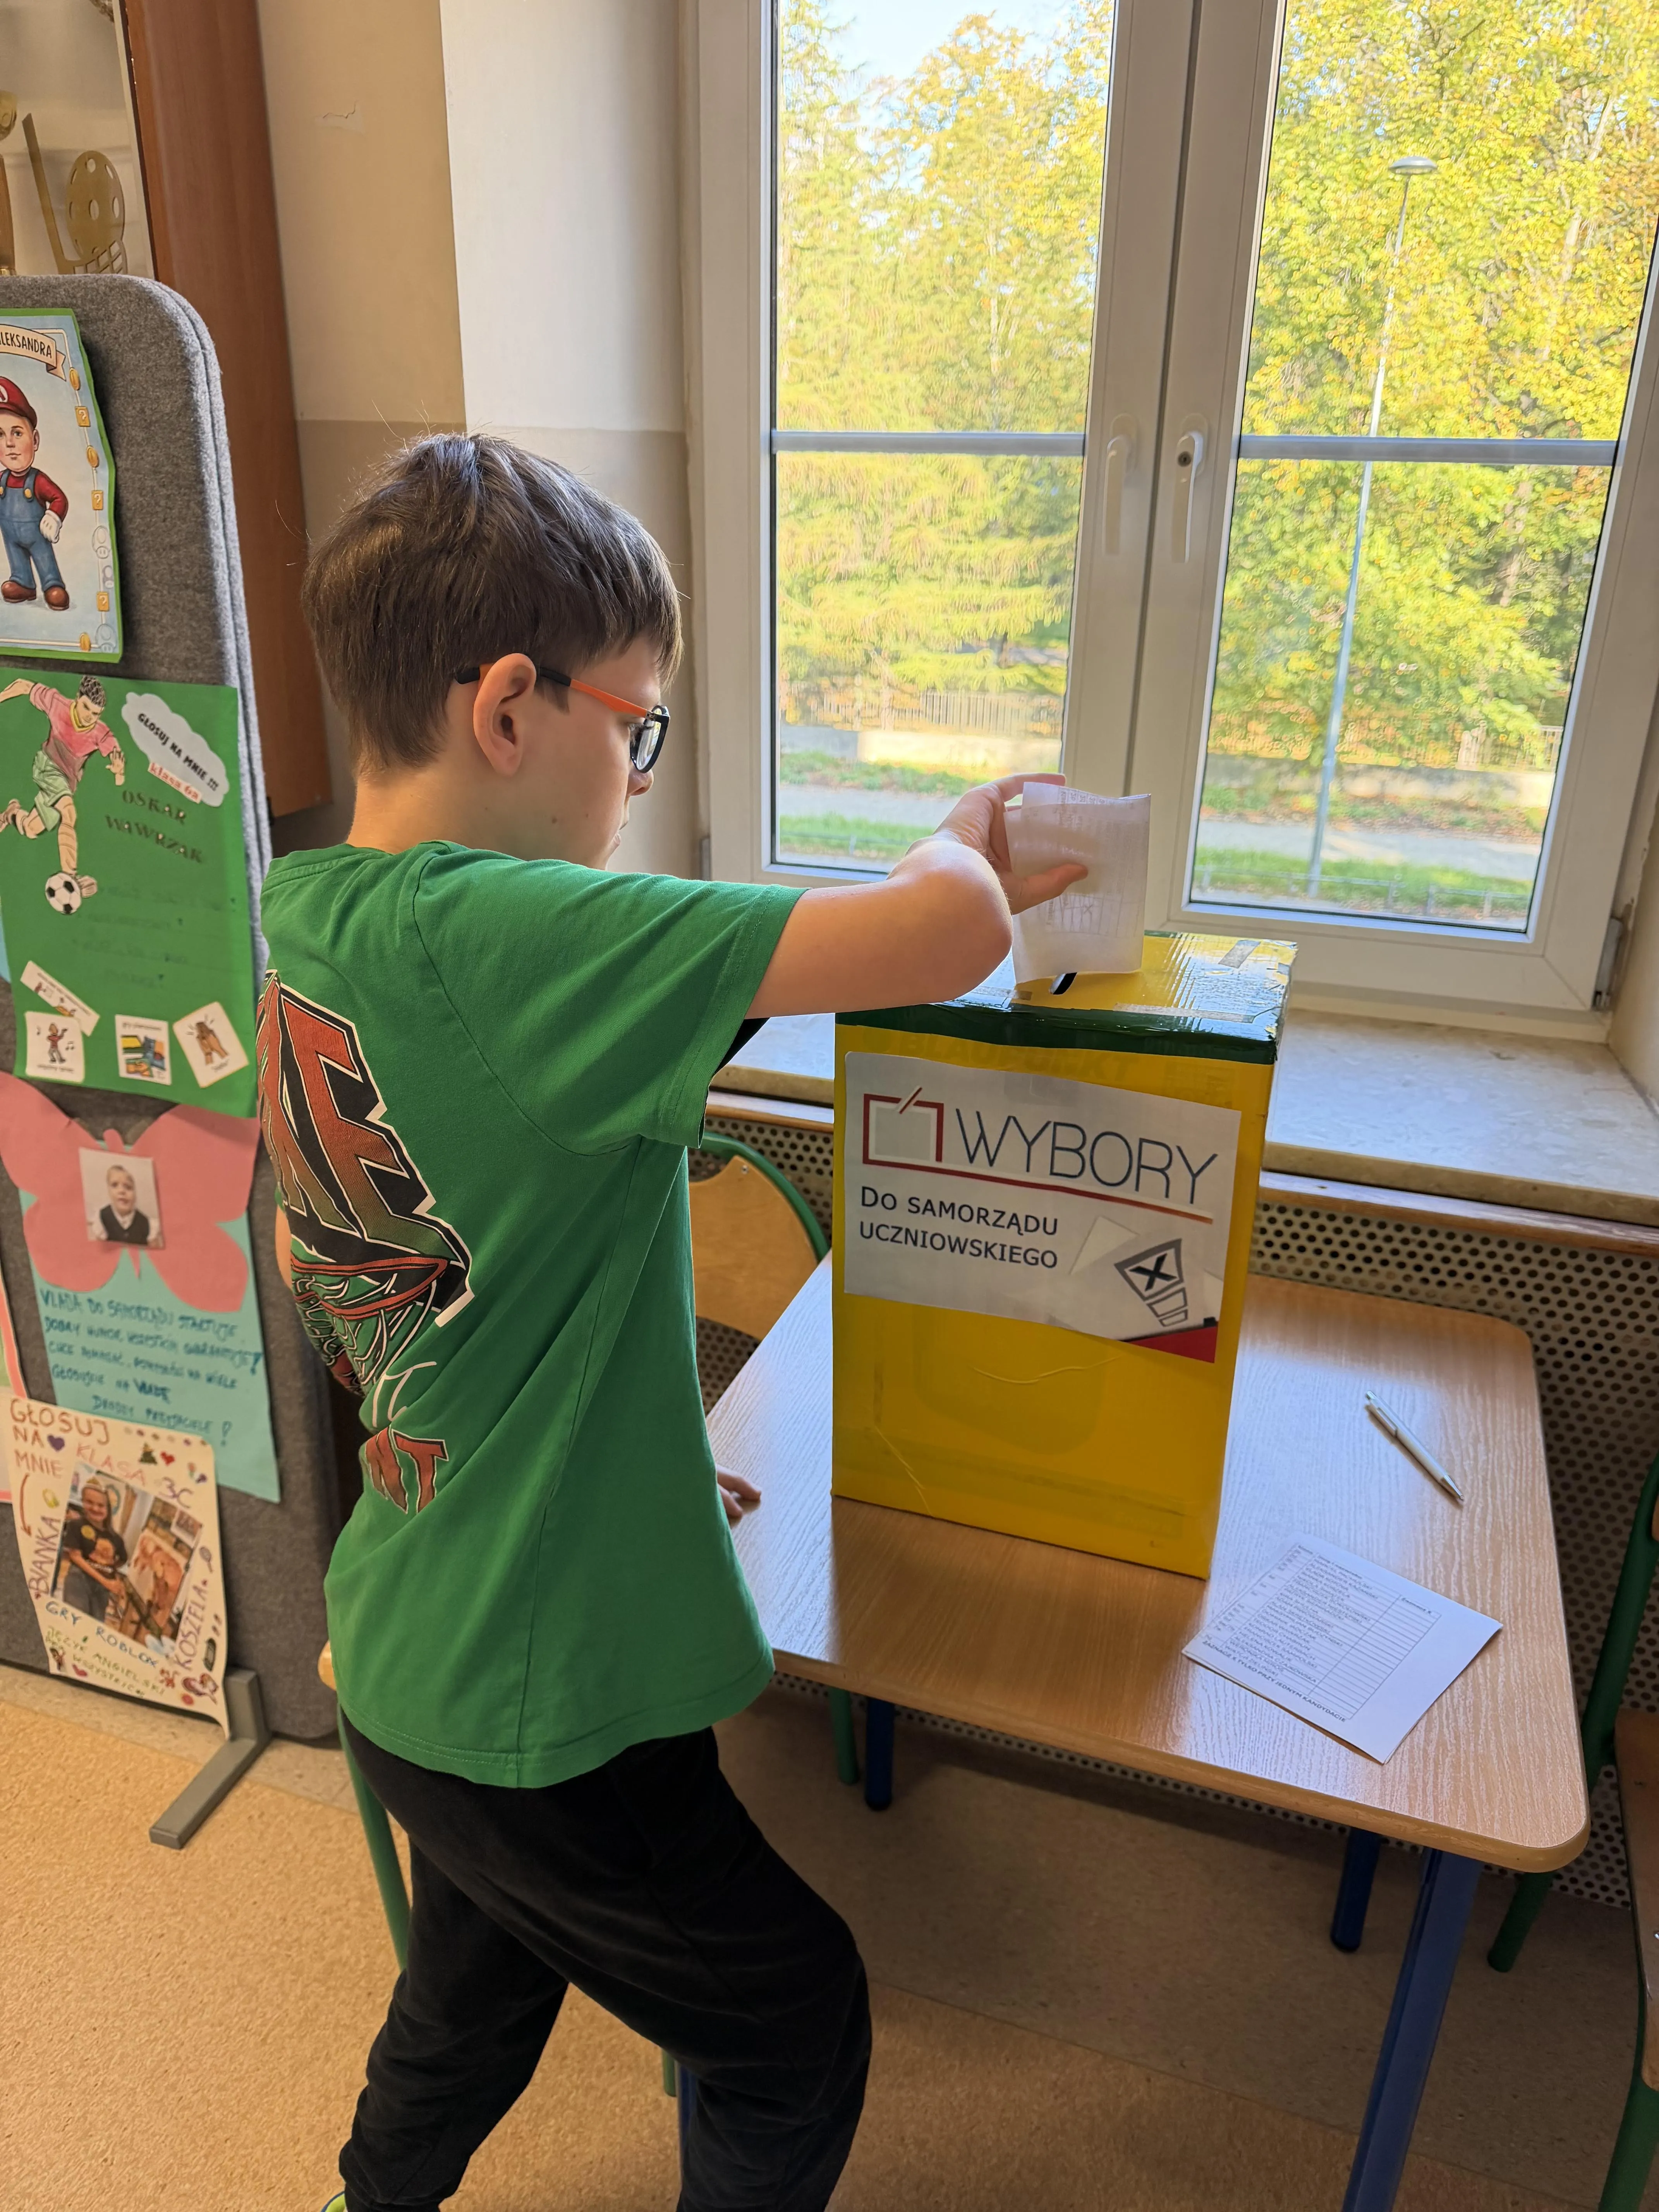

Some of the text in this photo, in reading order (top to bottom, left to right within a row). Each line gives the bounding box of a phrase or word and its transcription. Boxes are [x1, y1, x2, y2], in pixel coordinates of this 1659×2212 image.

[0, 331, 52, 359] LEKSANDRA
[137, 713, 170, 746] GŁOSUJ
[170, 742, 182, 758] NA
[183, 756, 208, 781] MNIE
[150, 762, 199, 800] klasa 6a
[122, 790, 186, 826] OSKAR
[955, 1108, 1218, 1204] WYBORY
[907, 1196, 1058, 1236] SAMORZĄDU
[860, 1221, 1058, 1269] UCZNIOWSKIEGO
[10, 1398, 110, 1445] GŁOSUJ
[12, 1425, 44, 1448] NA
[14, 1449, 63, 1479] MNIE
[76, 1443, 146, 1487] KLASA
[28, 1516, 61, 1594] BIANKA
[45, 1601, 159, 1668] GRY ROBLOX
[1236, 1659, 1258, 1673] TYLKO
[1256, 1671, 1276, 1683] PRZY
[1274, 1681, 1303, 1698] JEDNYM
[1301, 1696, 1347, 1723] KANDYDACIE
